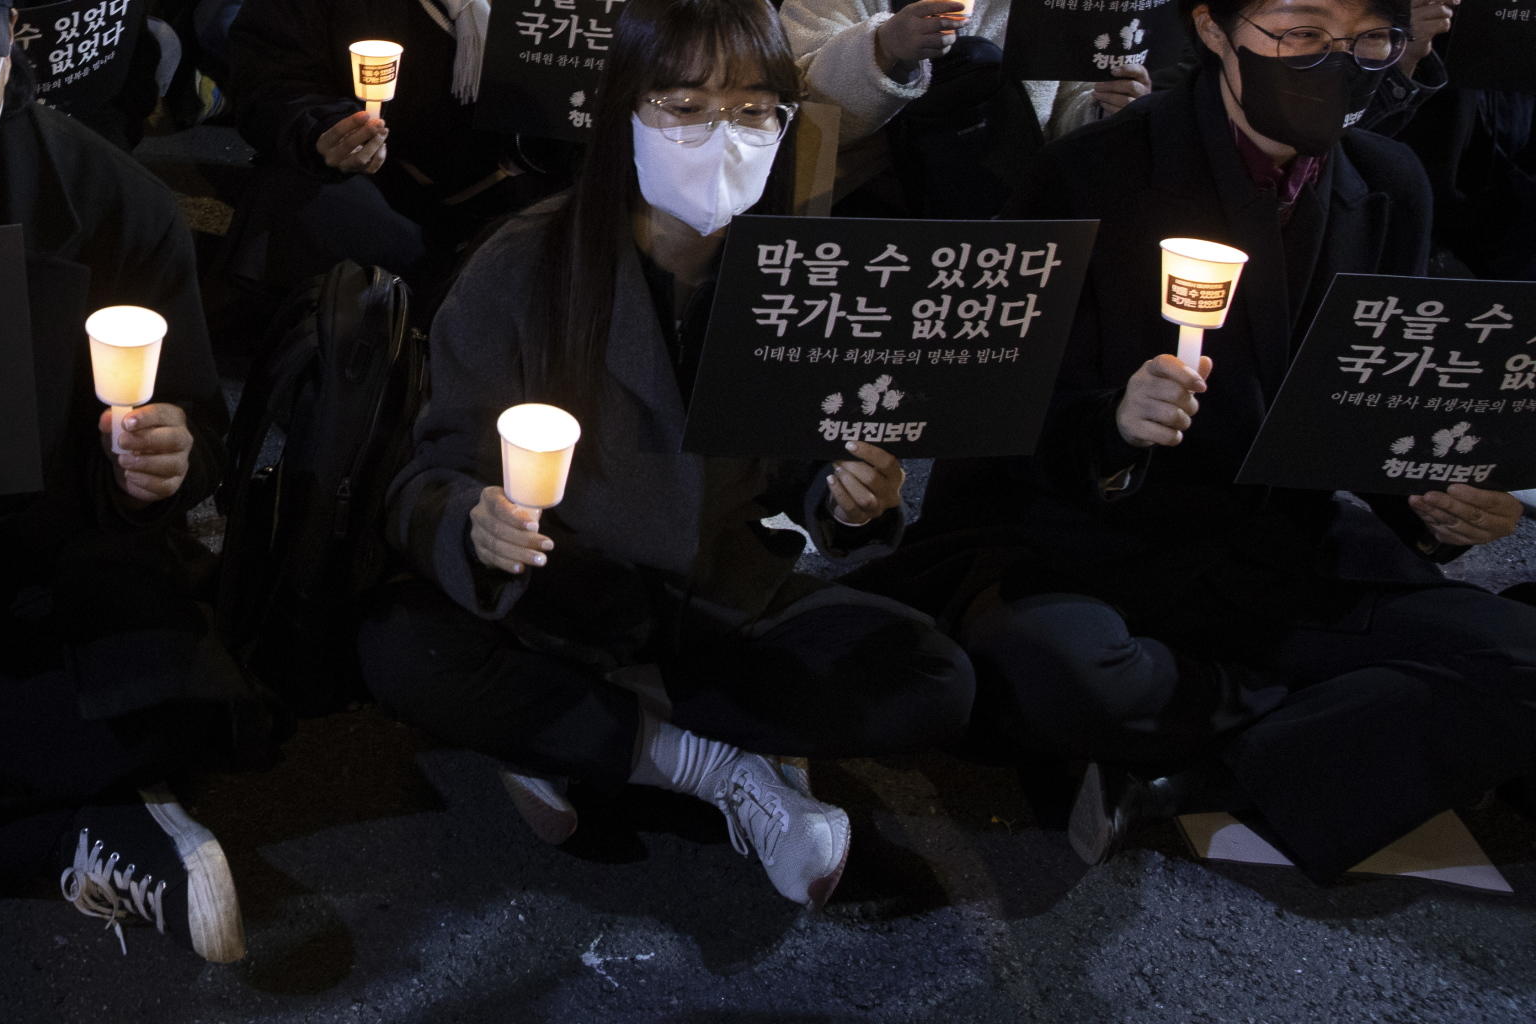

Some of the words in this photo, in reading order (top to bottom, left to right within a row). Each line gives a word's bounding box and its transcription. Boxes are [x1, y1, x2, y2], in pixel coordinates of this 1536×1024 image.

[14, 23, 43, 50] 수
[48, 20, 125, 75] 없었다
[516, 11, 614, 51] 국가는
[756, 239, 850, 287] 막을
[863, 243, 911, 288] 수
[929, 242, 1062, 289] 있었다
[751, 292, 892, 339] 국가는
[910, 293, 1042, 340] 없었다
[1353, 296, 1450, 341] 막을
[1465, 303, 1514, 344] 수
[753, 345, 802, 363] 이태원
[807, 347, 839, 364] 참사
[843, 347, 922, 366] 희생자들의
[927, 349, 971, 365] 명복을
[976, 347, 1020, 364] 빕니다
[1336, 344, 1484, 389] 국가는
[1330, 390, 1379, 408] 이태원
[1385, 393, 1419, 410] 참사
[1423, 396, 1504, 413] 희생자들의
[818, 417, 927, 443] 청년진보당
[1381, 457, 1497, 483] 청년진보당
